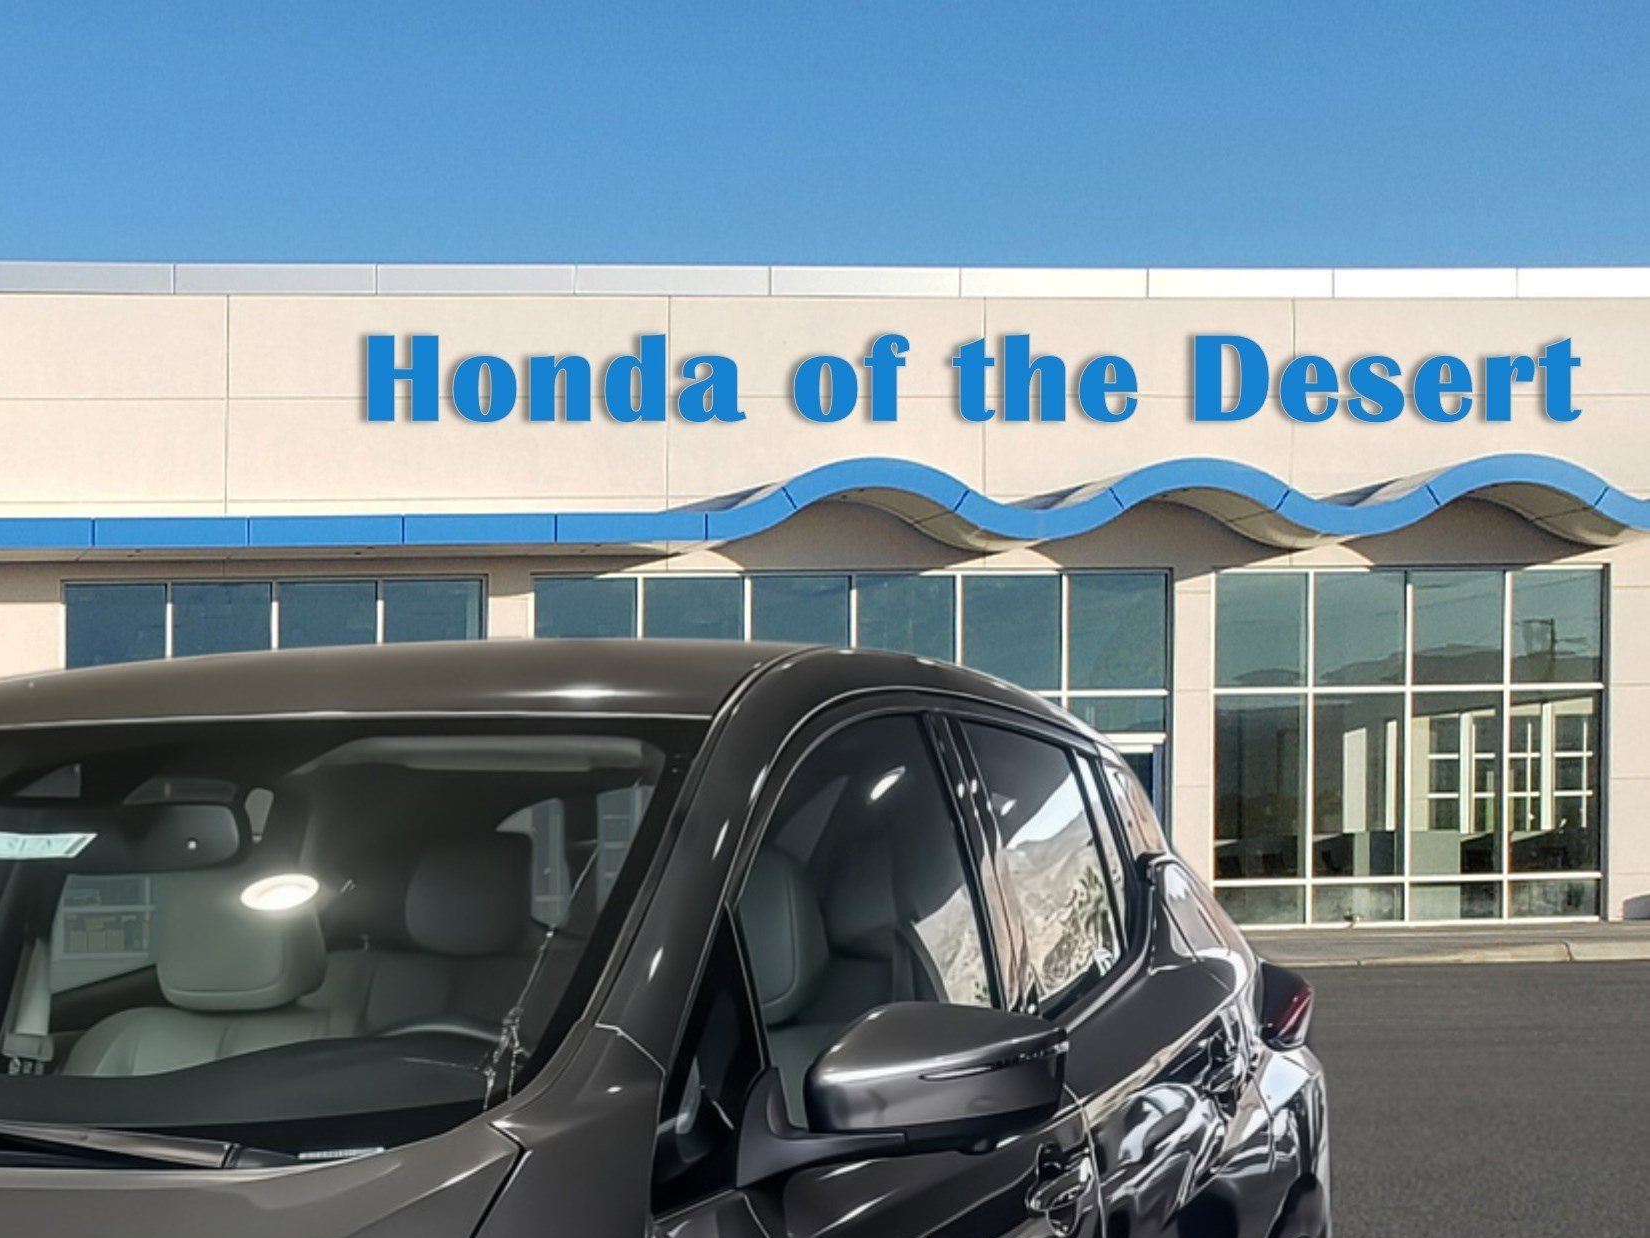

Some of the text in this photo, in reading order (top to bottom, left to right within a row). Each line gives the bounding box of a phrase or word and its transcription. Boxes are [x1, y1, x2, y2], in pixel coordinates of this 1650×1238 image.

[366, 333, 1583, 423] Honda of the Desert
